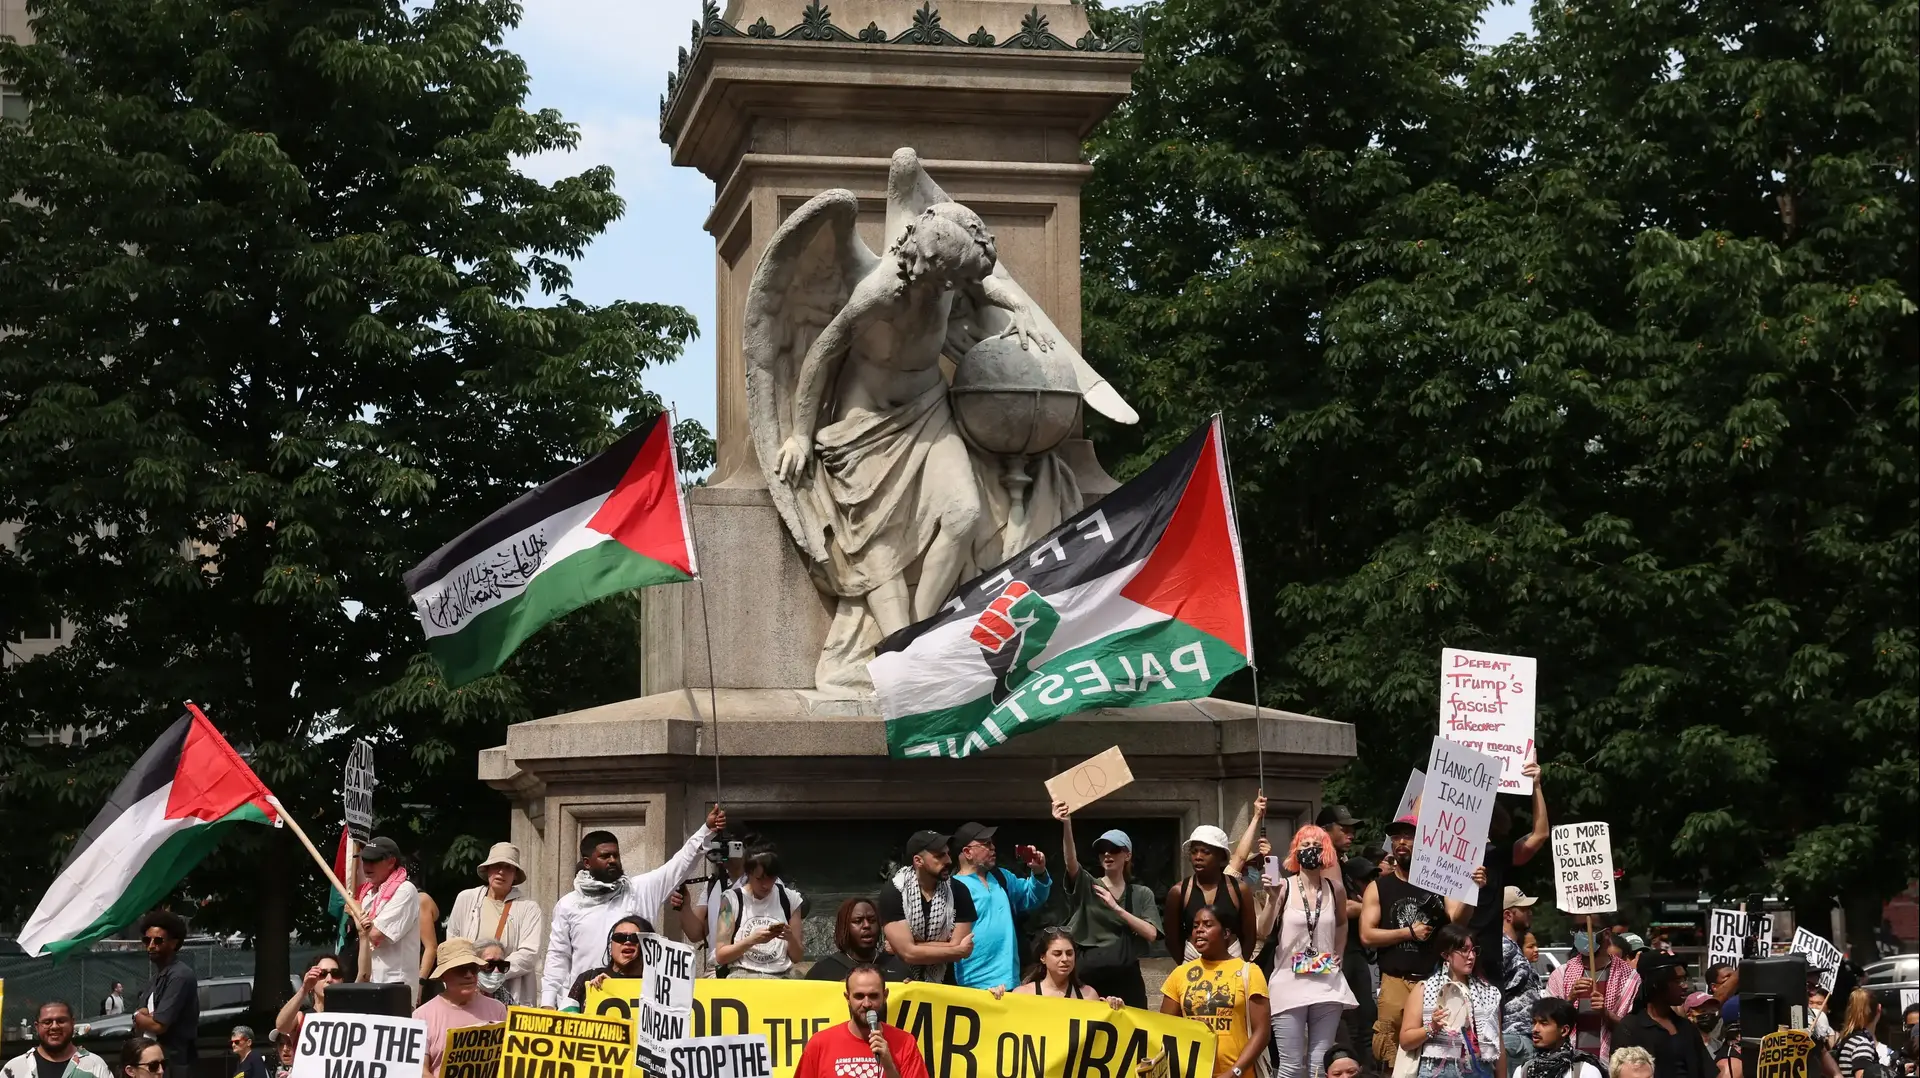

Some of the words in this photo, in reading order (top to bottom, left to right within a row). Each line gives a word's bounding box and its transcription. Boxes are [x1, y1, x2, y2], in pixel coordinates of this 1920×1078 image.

[1453, 655, 1511, 672] DEFEAT
[1446, 673, 1523, 699] Trump's
[1447, 692, 1508, 718] fascist
[1447, 714, 1505, 732] takeover
[354, 770, 360, 789] A
[1438, 782, 1482, 813] IRAN!
[1438, 810, 1466, 836] NO
[1555, 828, 1569, 840] NO
[1576, 824, 1605, 838] MORE
[1556, 844, 1571, 856] U.S.
[1573, 840, 1597, 854] TAX
[1560, 854, 1604, 868] DOLLARS
[1562, 871, 1579, 882] FOR
[1576, 894, 1611, 908] BOMBS
[1711, 935, 1724, 952] IS
[1727, 938, 1737, 953] A
[1799, 929, 1840, 965] TRUMP
[665, 946, 692, 980] THE
[515, 1014, 553, 1033] TRUMP
[555, 1020, 562, 1034] &
[563, 1019, 626, 1041] NETANYAHU:
[301, 1021, 367, 1058] STOP
[373, 1024, 424, 1064] THE
[507, 1034, 554, 1057] NO
[558, 1040, 630, 1066] NEW
[996, 1031, 1046, 1078] ON
[447, 1049, 495, 1064] SHOULD
[670, 1045, 727, 1078] STOP
[728, 1042, 769, 1078] THE
